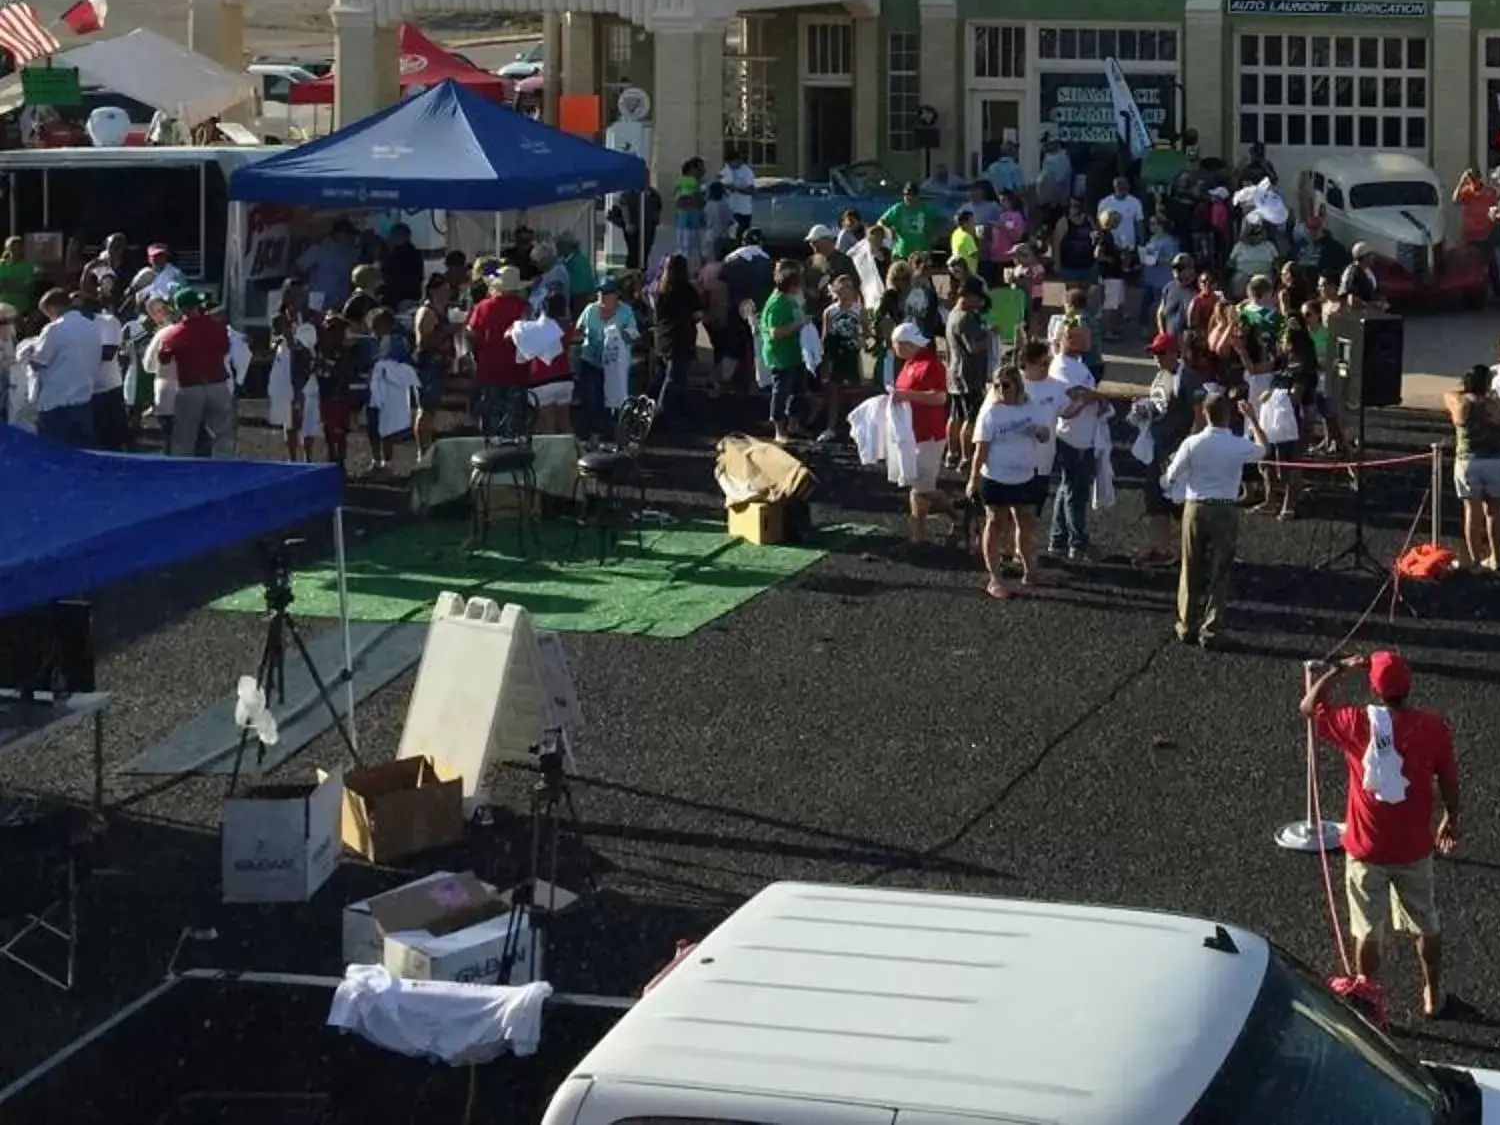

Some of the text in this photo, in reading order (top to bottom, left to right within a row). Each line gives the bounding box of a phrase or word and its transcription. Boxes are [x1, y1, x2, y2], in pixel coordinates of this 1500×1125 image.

[1231, 0, 1426, 15] AUTO LAUNDRY LUBRICATION
